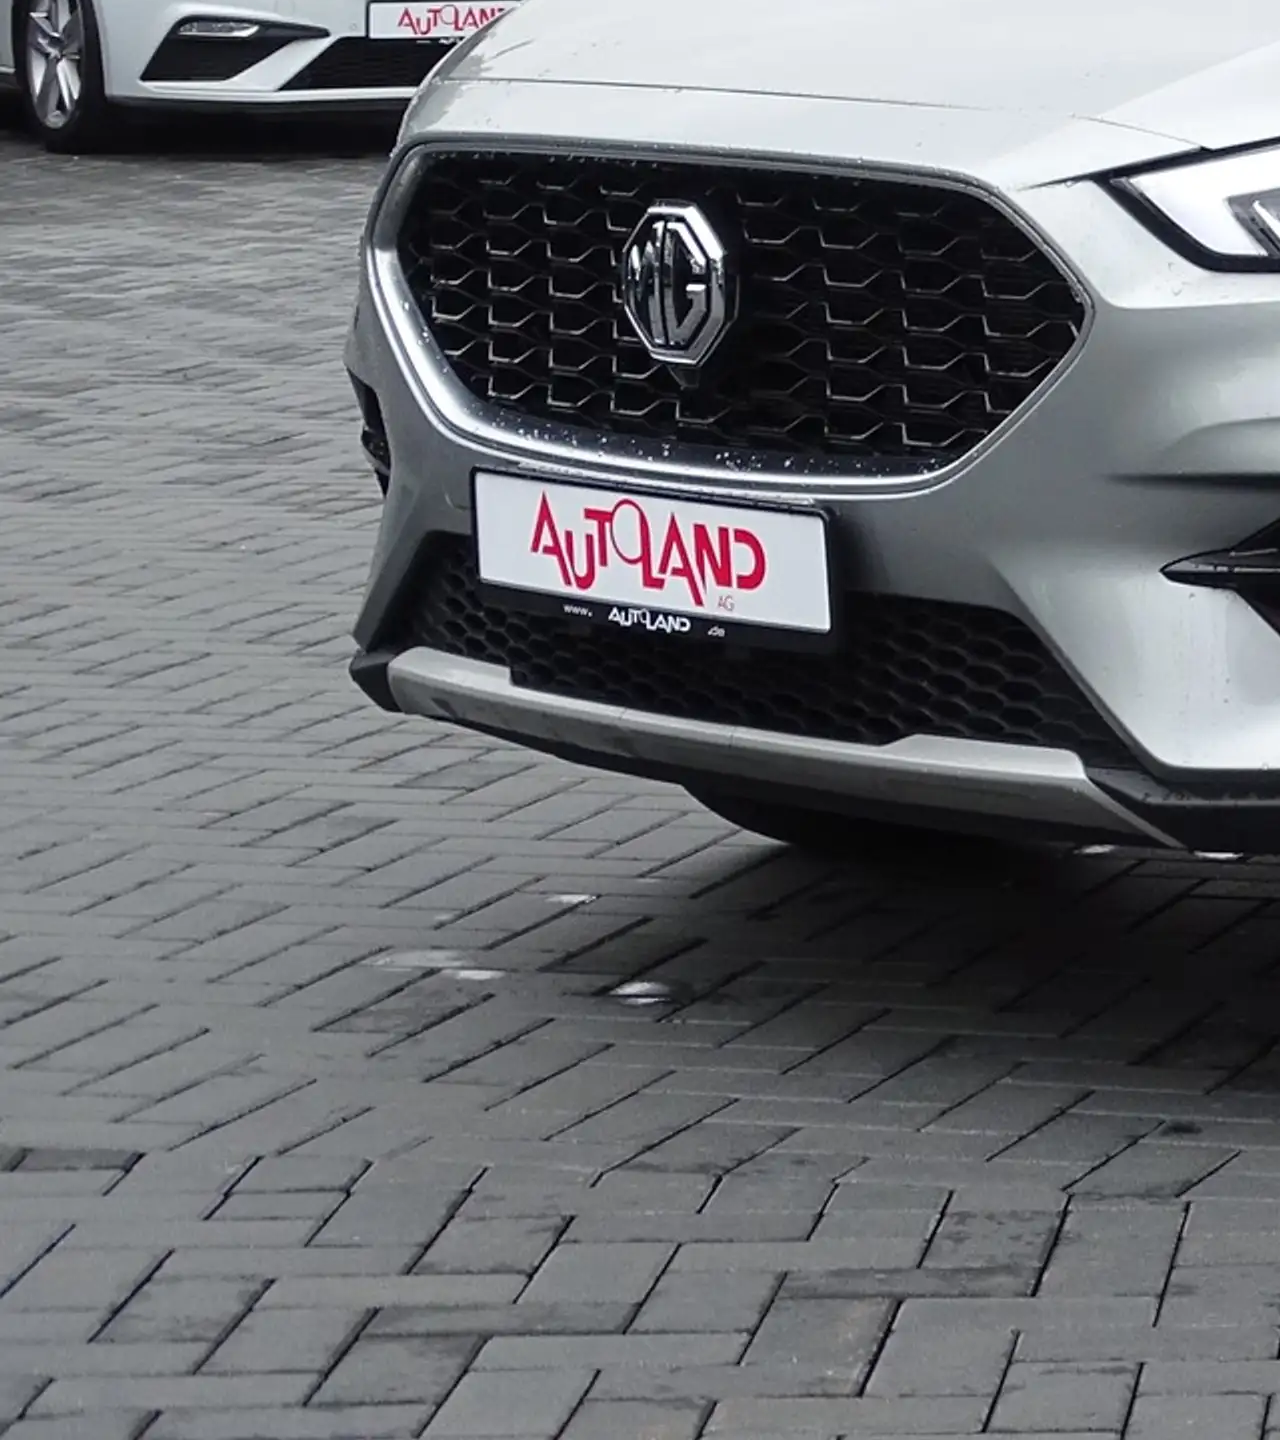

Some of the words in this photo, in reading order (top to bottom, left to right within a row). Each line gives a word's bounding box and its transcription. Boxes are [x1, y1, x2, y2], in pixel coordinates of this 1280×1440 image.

[397, 4, 505, 35] AUTOLAN
[531, 490, 767, 608] AUTOLAND
[608, 607, 692, 634] AUTOLAND
